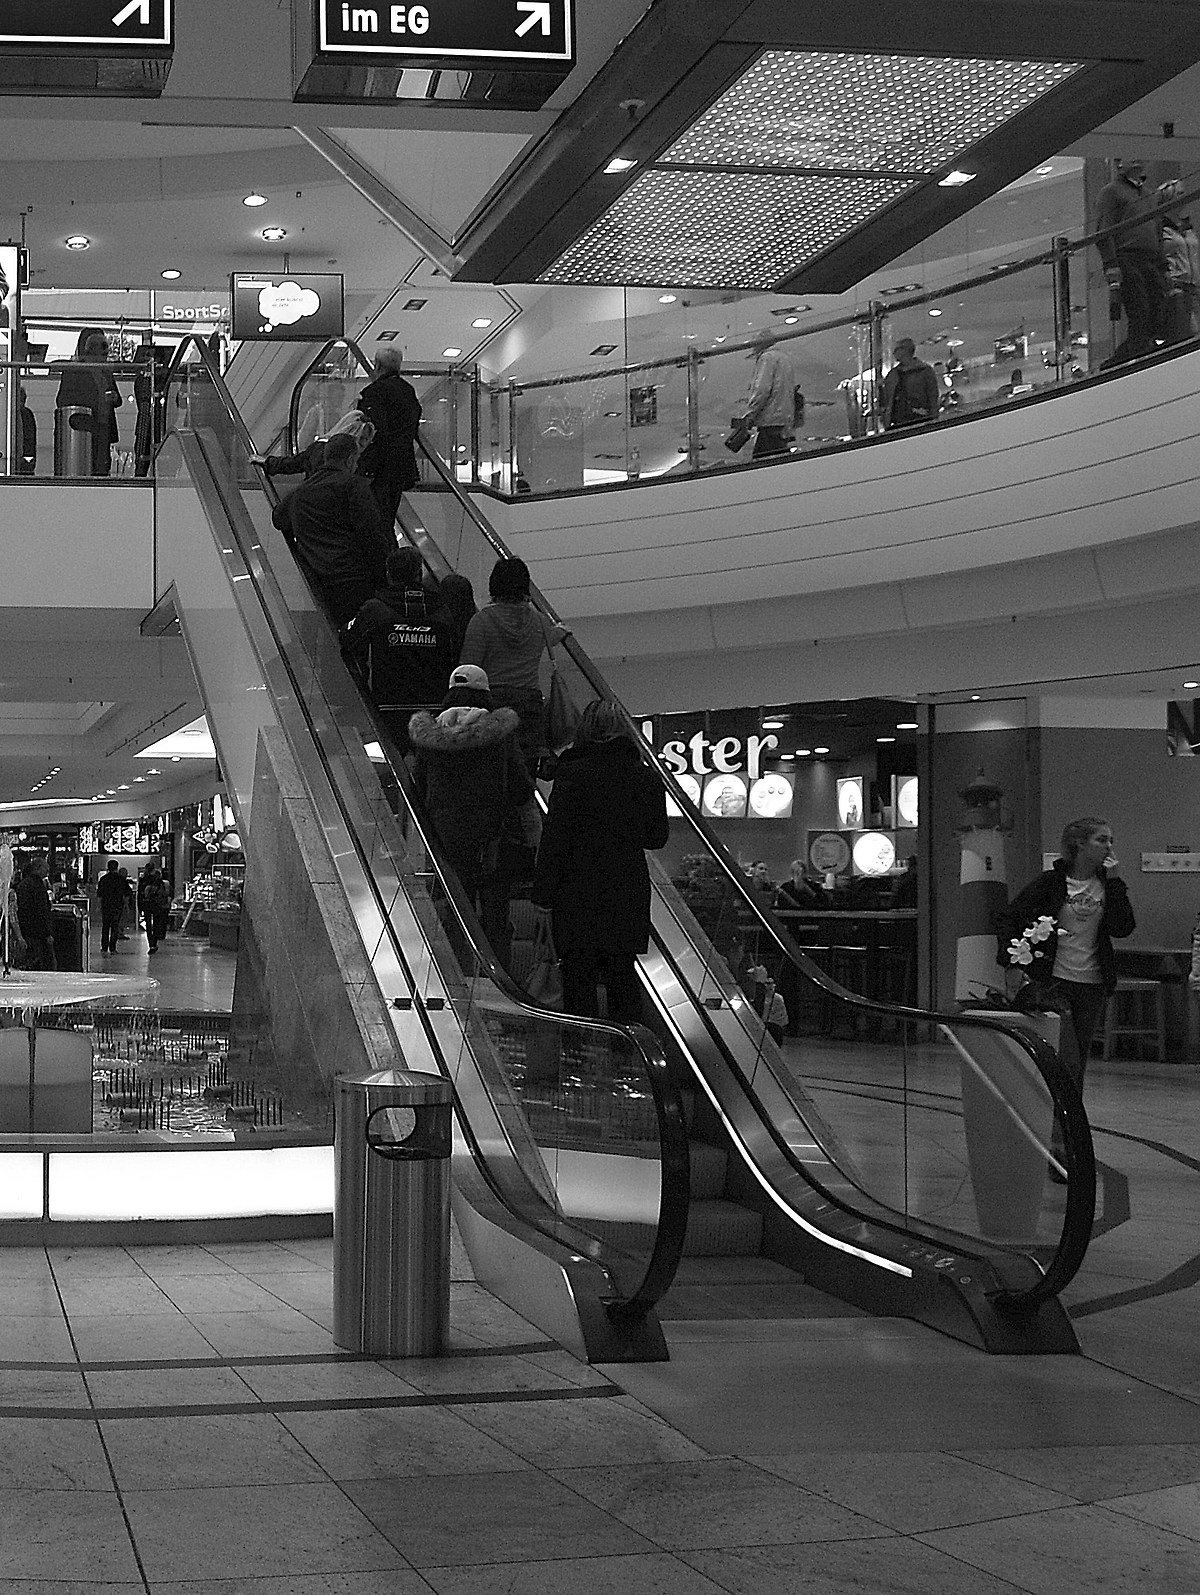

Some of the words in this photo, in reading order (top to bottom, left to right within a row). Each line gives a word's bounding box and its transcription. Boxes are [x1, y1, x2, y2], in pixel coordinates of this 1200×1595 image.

[342, 2, 378, 33] im
[390, 4, 429, 35] EG
[399, 632, 437, 644] YAMAHA
